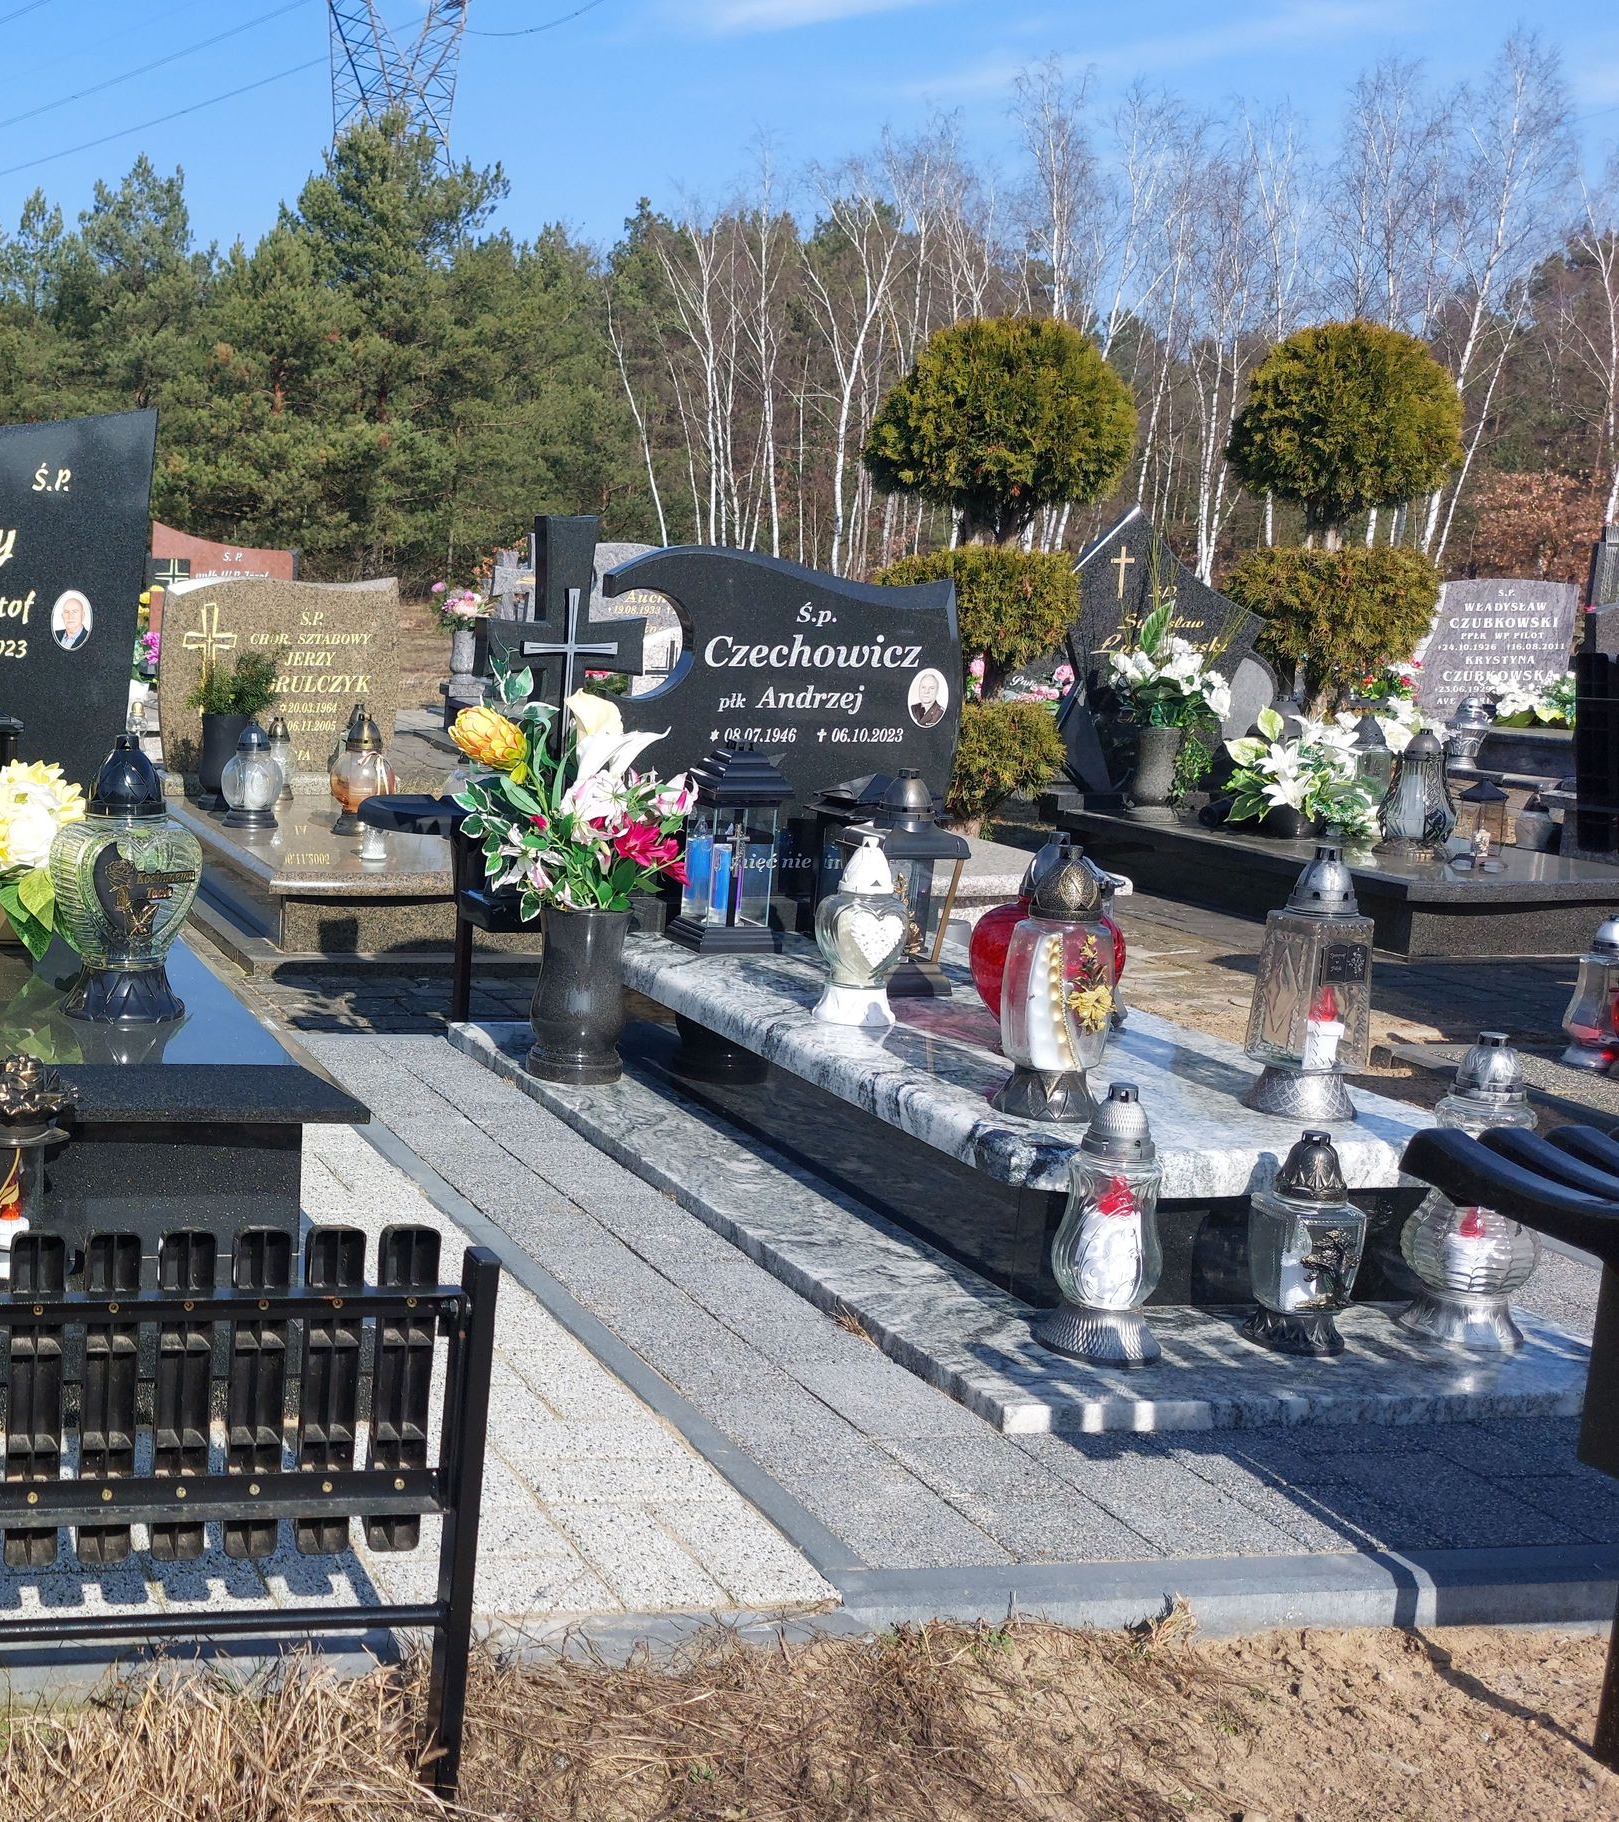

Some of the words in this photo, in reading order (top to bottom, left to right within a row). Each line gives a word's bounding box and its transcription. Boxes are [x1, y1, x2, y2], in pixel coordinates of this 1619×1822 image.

[32, 462, 71, 492] Ś.P.
[1464, 602, 1547, 612] WŁADYSŁAW
[300, 608, 324, 626] Ś.P.
[796, 602, 837, 627] Ś.p.
[1449, 617, 1559, 629] CZUBKOWSKI
[298, 633, 372, 645] SZTABOWY
[1461, 632, 1487, 640] PPŁK
[1494, 632, 1510, 640] WP
[1513, 632, 1544, 640] PILOT
[704, 634, 923, 668] Czechowicz
[284, 652, 337, 667] JERZY
[1465, 656, 1535, 664] KRYSTYNA
[717, 693, 746, 712] płk
[755, 685, 865, 714] Andrzej
[287, 703, 338, 714] 20.03.1964
[287, 720, 337, 732] 06.11.2005
[724, 727, 797, 743] 0807.1946
[831, 728, 904, 743] 06.10.2023
